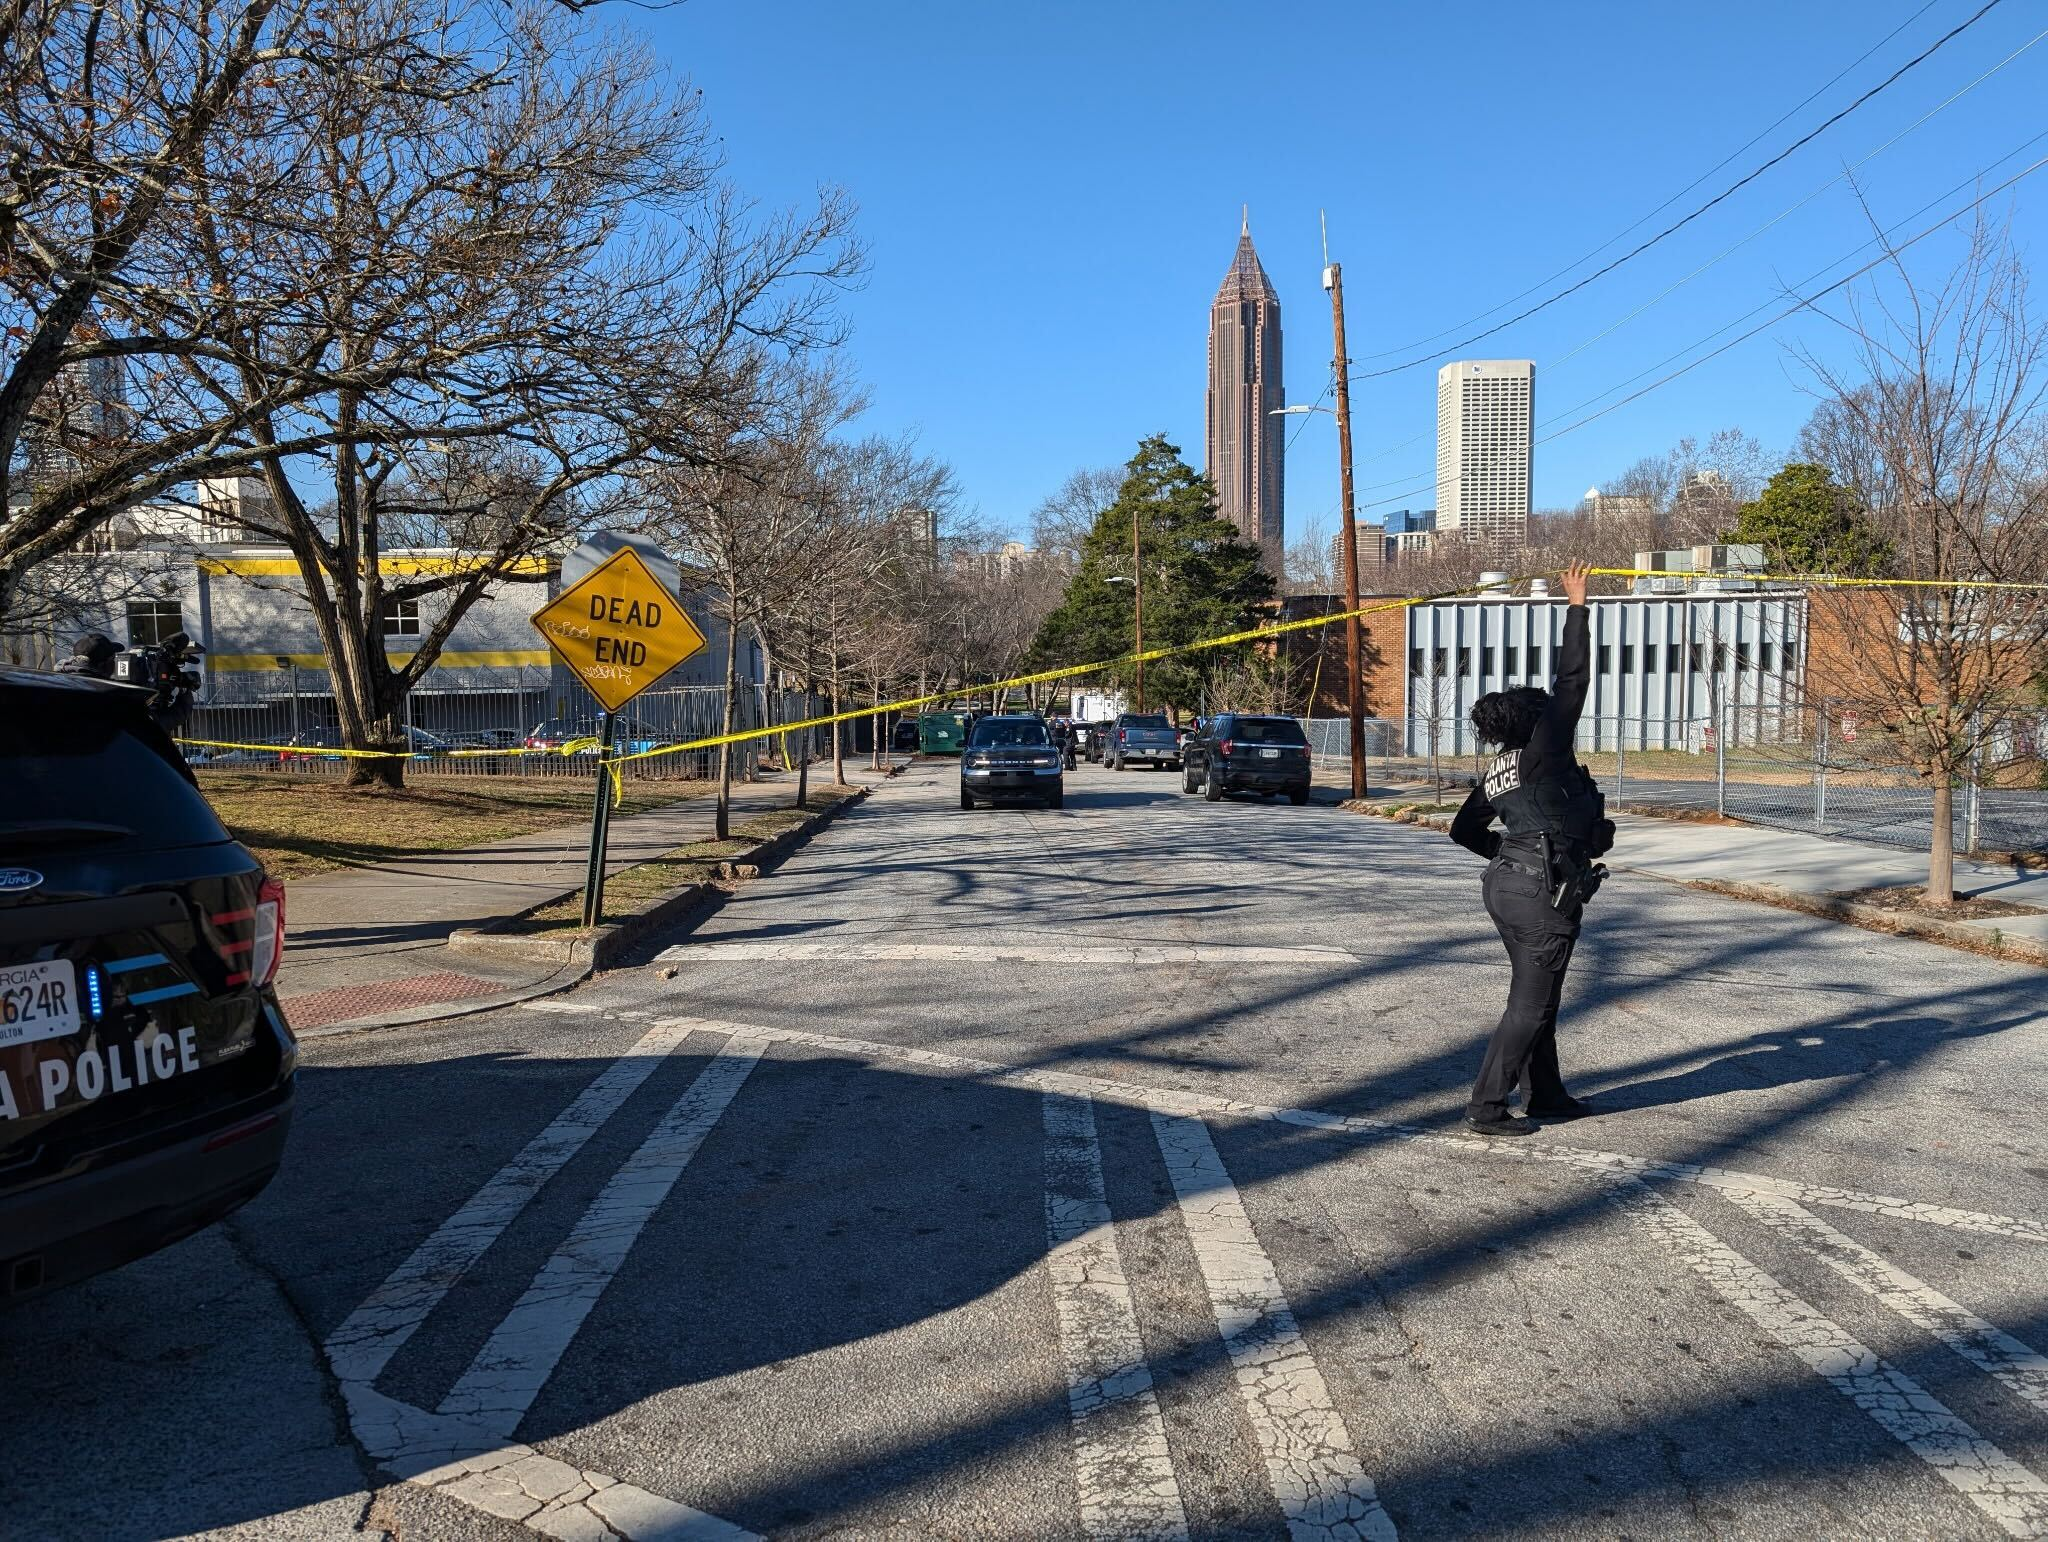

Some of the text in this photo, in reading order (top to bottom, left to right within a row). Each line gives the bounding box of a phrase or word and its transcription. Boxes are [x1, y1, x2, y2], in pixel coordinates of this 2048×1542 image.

[590, 594, 661, 628] DEAD
[595, 636, 647, 666] END
[1485, 769, 1518, 798] POLICE
[3, 981, 69, 1024] 624R
[40, 1026, 200, 1111] POLICE
